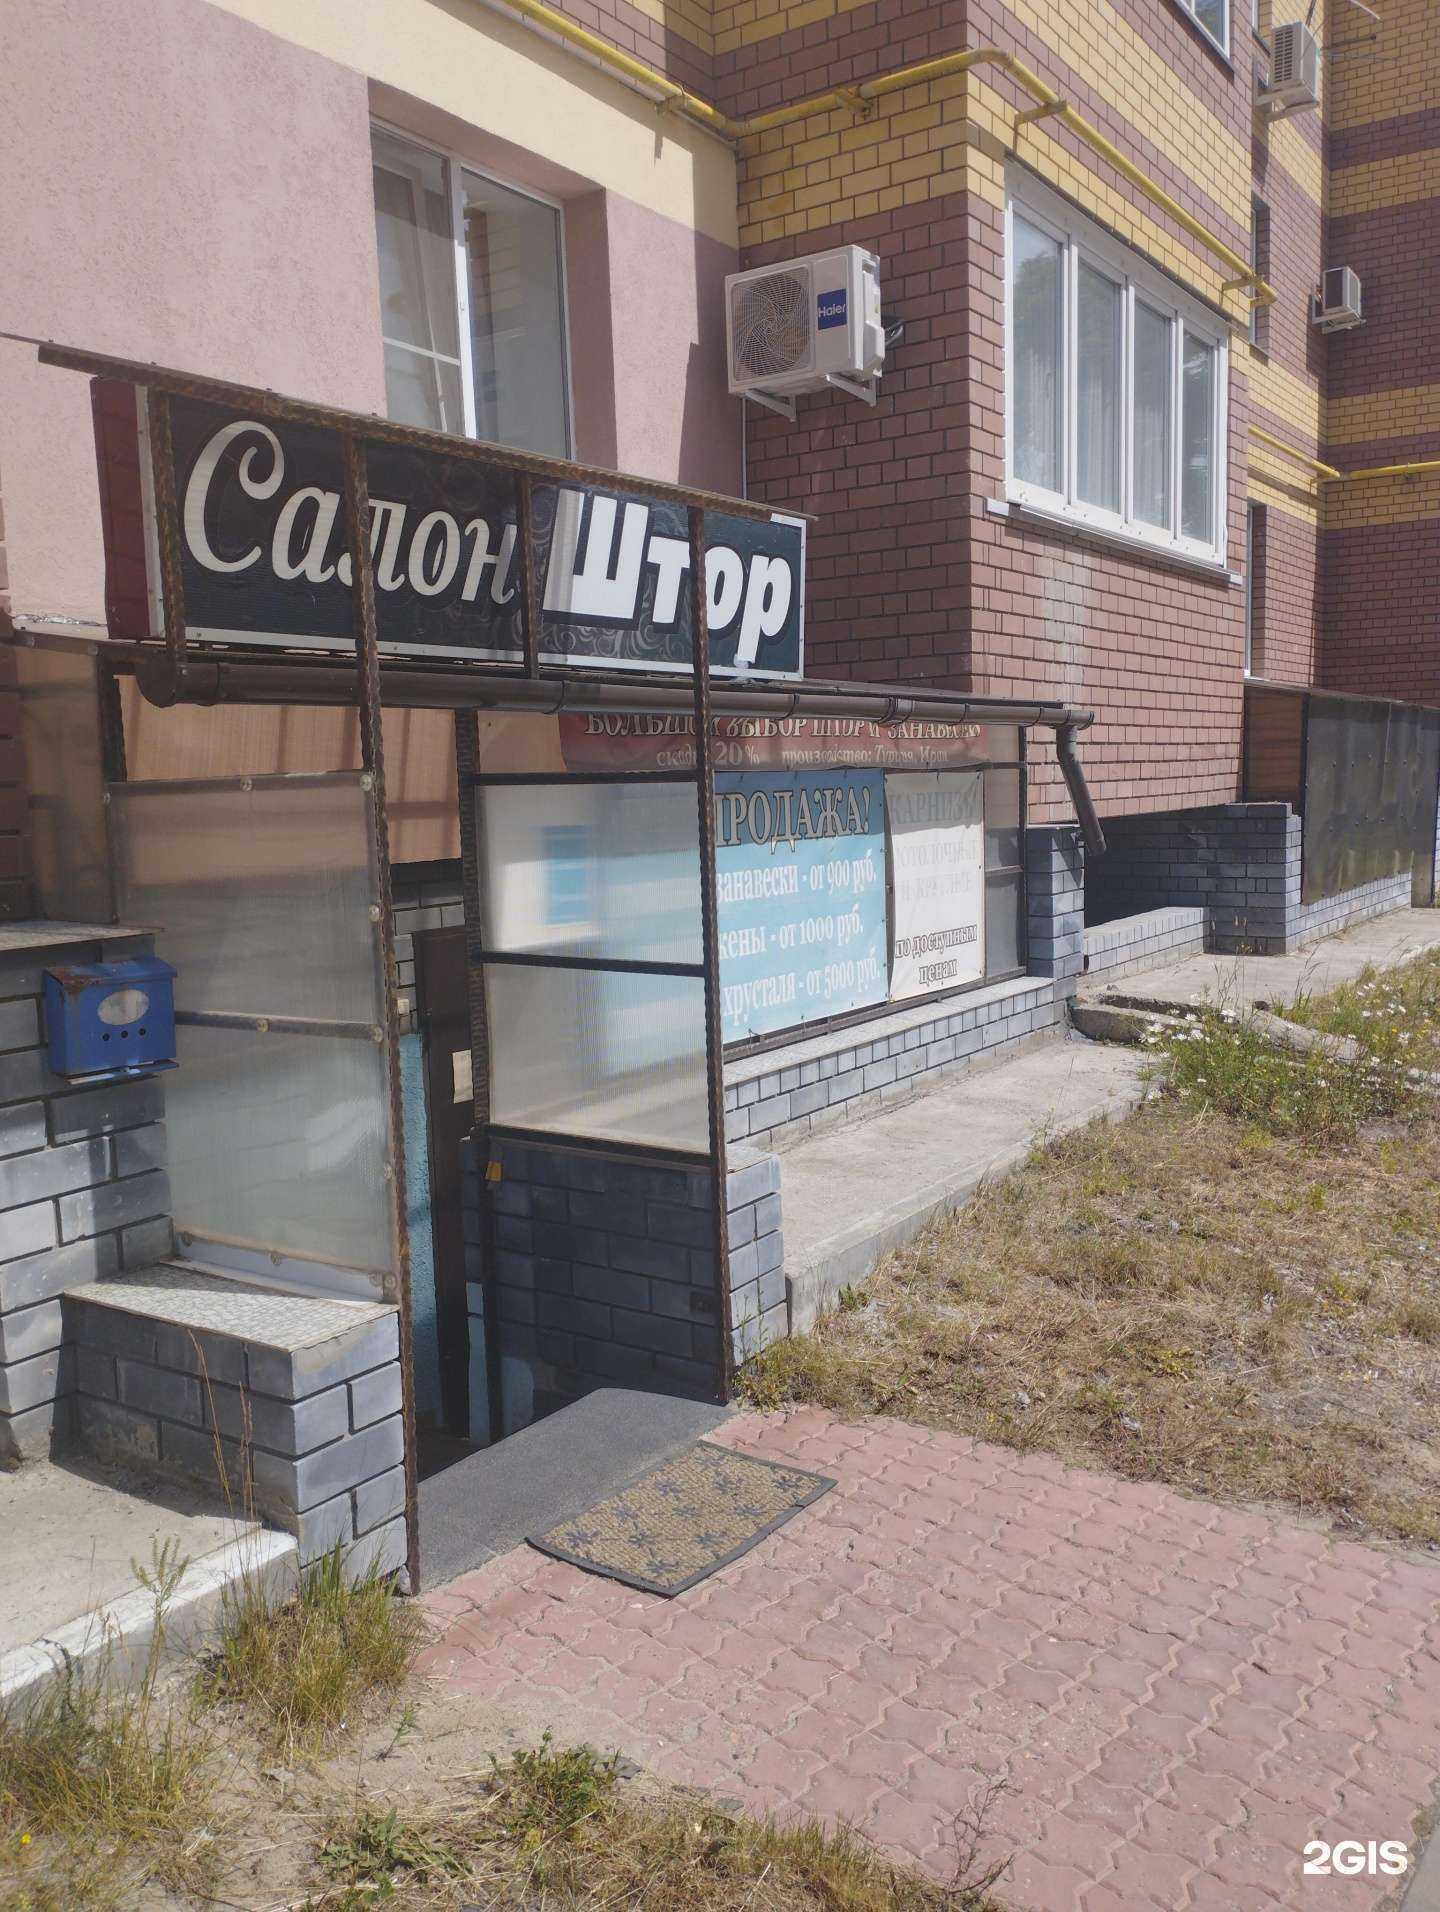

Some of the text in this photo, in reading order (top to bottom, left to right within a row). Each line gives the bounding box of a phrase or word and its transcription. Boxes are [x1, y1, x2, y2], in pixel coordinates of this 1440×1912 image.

[818, 303, 847, 318] Haier
[184, 419, 793, 663] Салон Штор
[810, 865, 826, 890] от
[827, 860, 849, 896] 900
[851, 848, 877, 894] руб.
[779, 922, 797, 951] от
[799, 915, 834, 946] 1000
[836, 904, 864, 946] руб.
[911, 925, 978, 959] доступным
[806, 970, 821, 996] от
[856, 948, 880, 993] руб.
[919, 959, 959, 987] ценам
